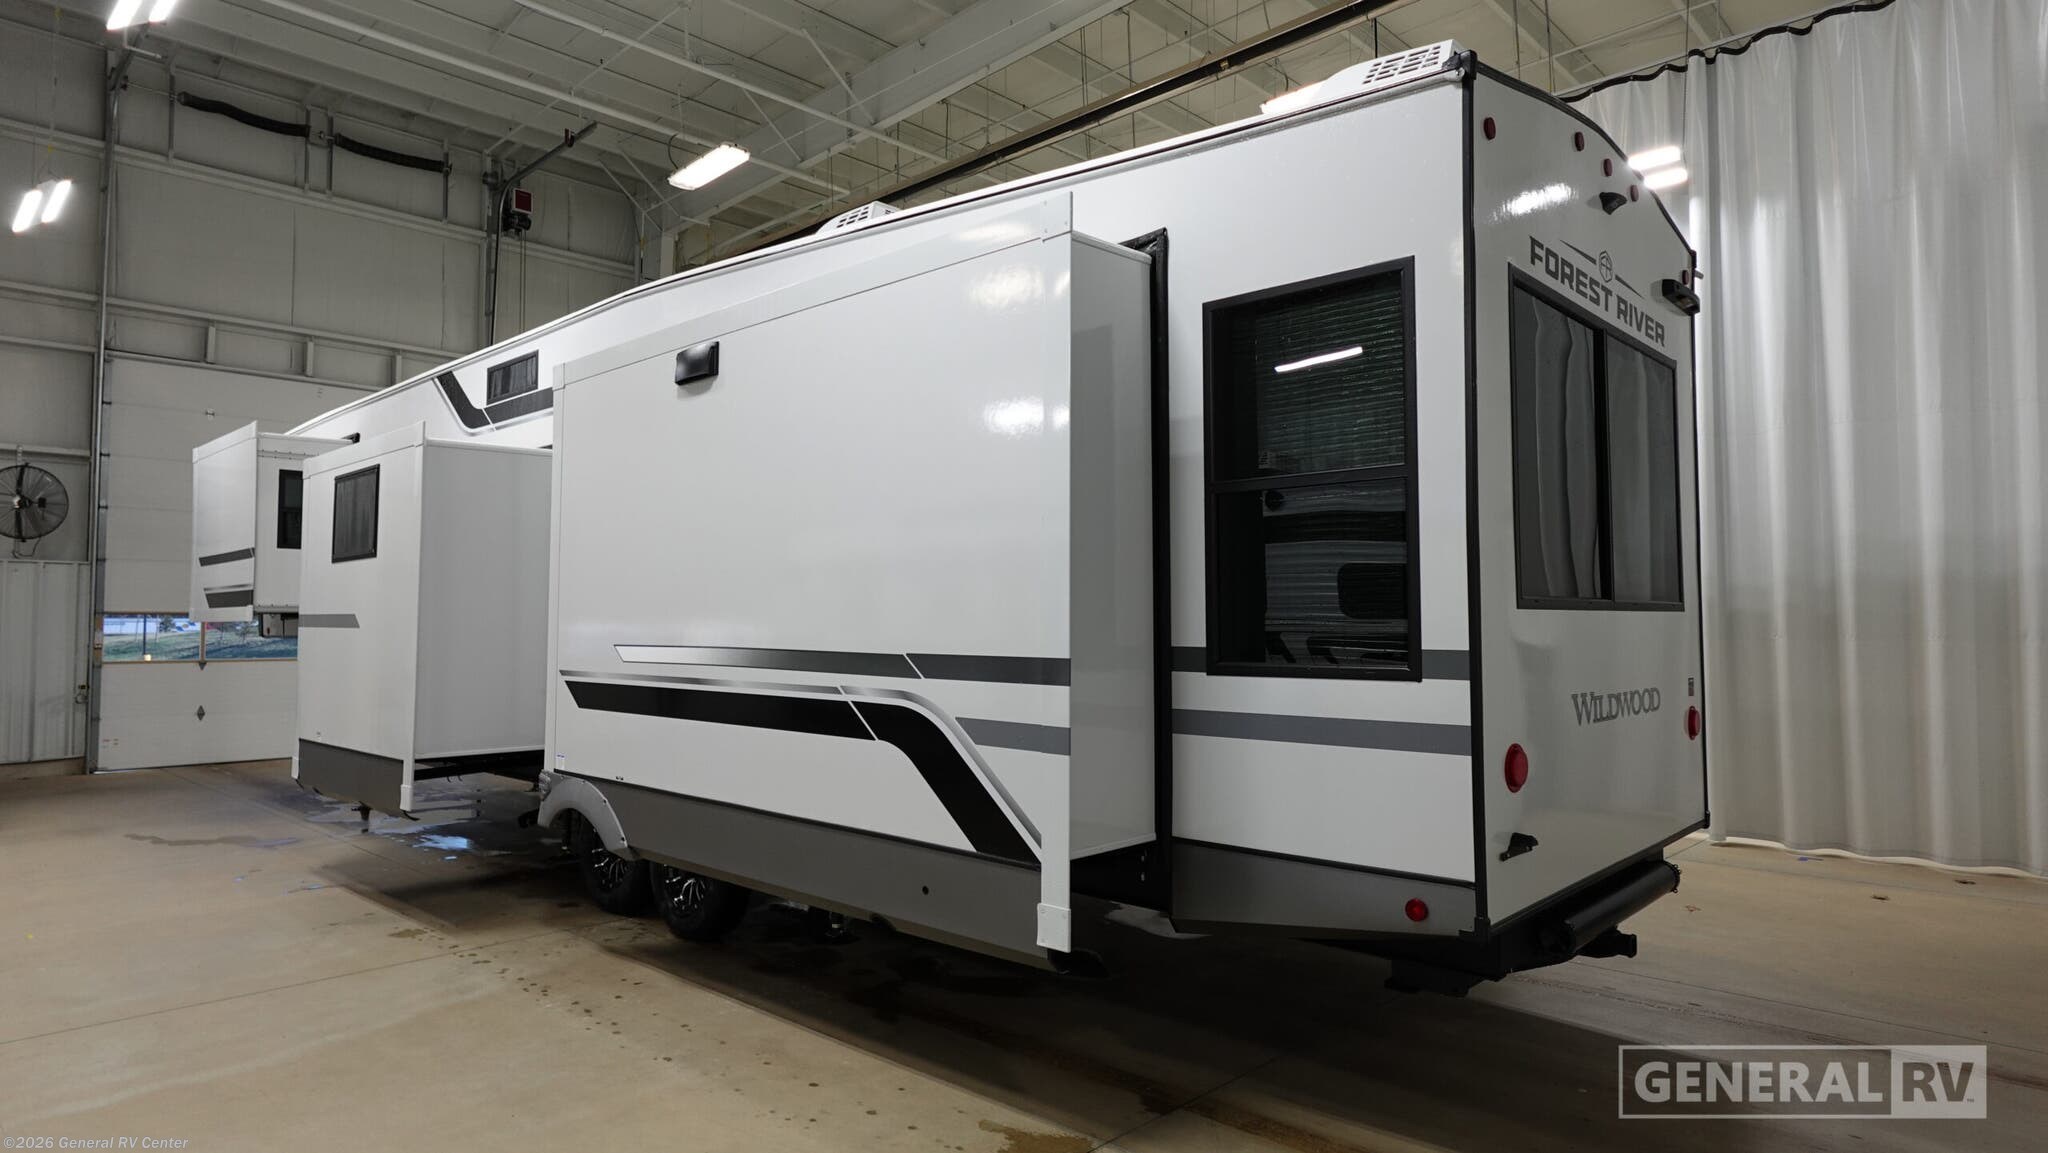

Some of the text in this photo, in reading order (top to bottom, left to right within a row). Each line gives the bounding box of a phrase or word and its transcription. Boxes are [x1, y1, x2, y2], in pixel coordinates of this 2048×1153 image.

[1530, 235, 1665, 347] FOREST RIVER
[1571, 687, 1661, 726] WILDWOOD
